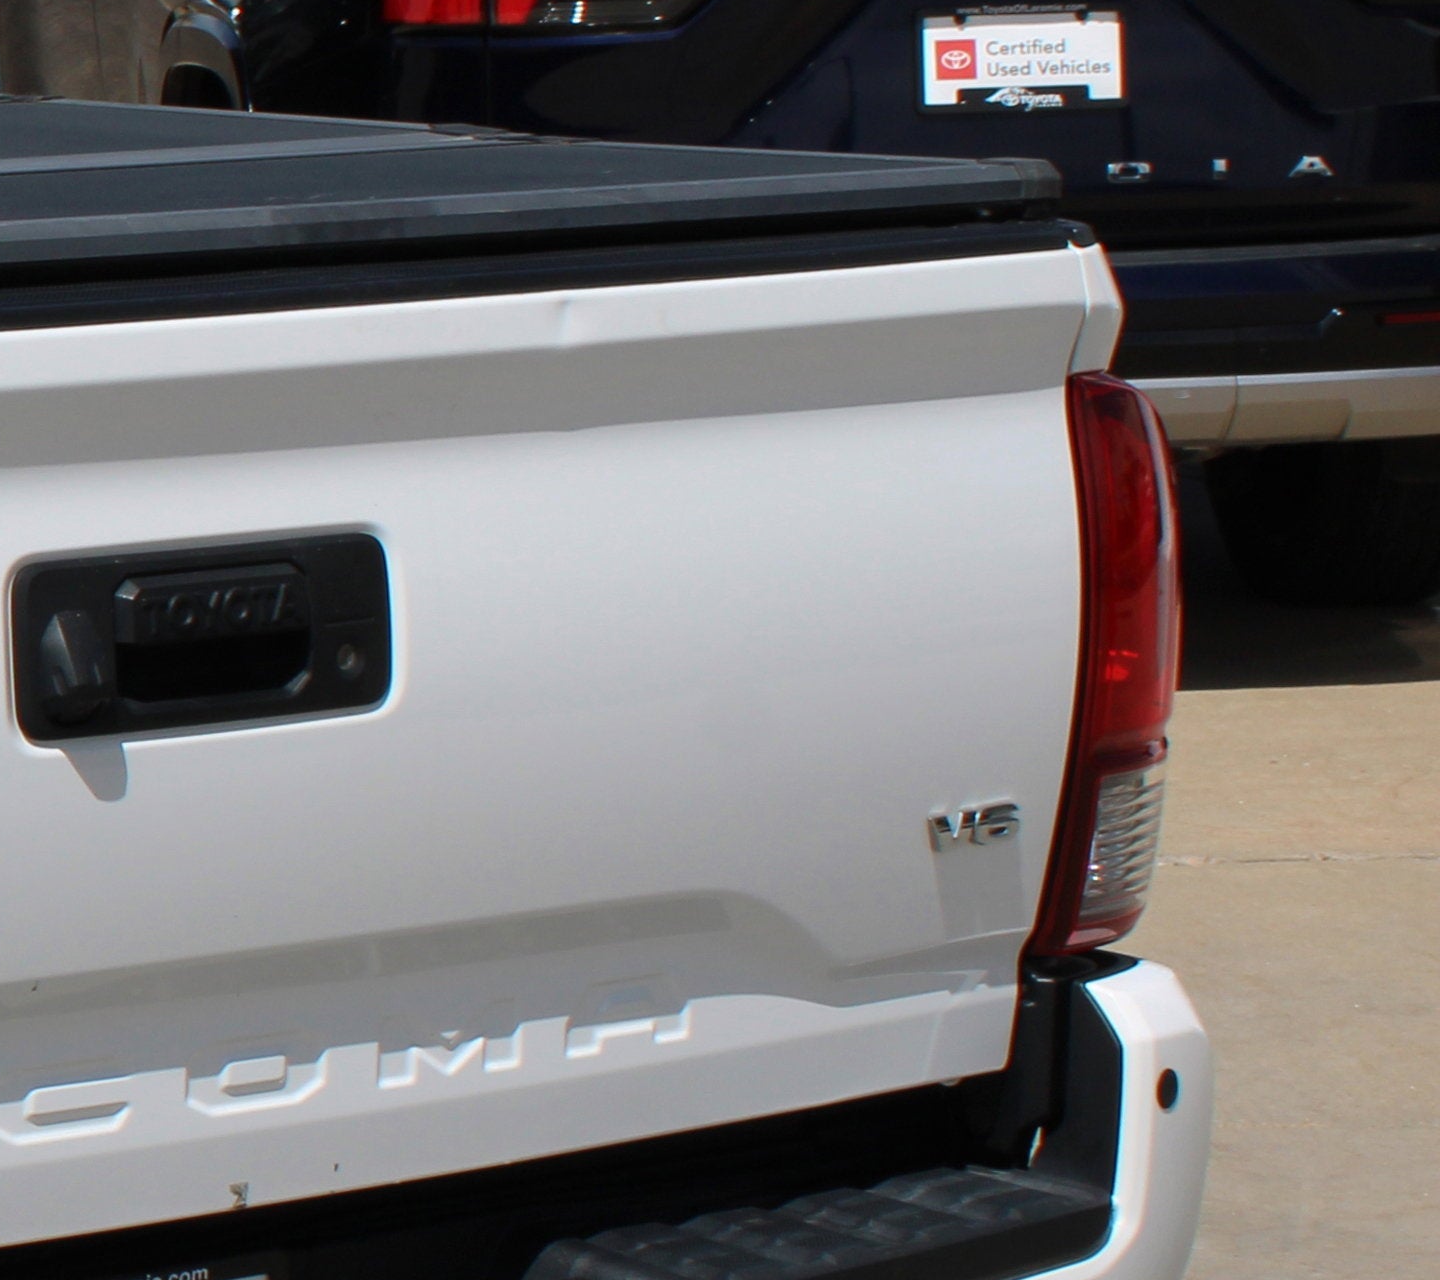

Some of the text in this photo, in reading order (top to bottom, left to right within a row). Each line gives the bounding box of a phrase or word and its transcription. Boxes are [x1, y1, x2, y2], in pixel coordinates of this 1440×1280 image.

[985, 38, 1066, 56] Certified
[986, 60, 1111, 77] Used Vehicles
[142, 581, 296, 638] TOYOTA
[927, 802, 1020, 851] V6
